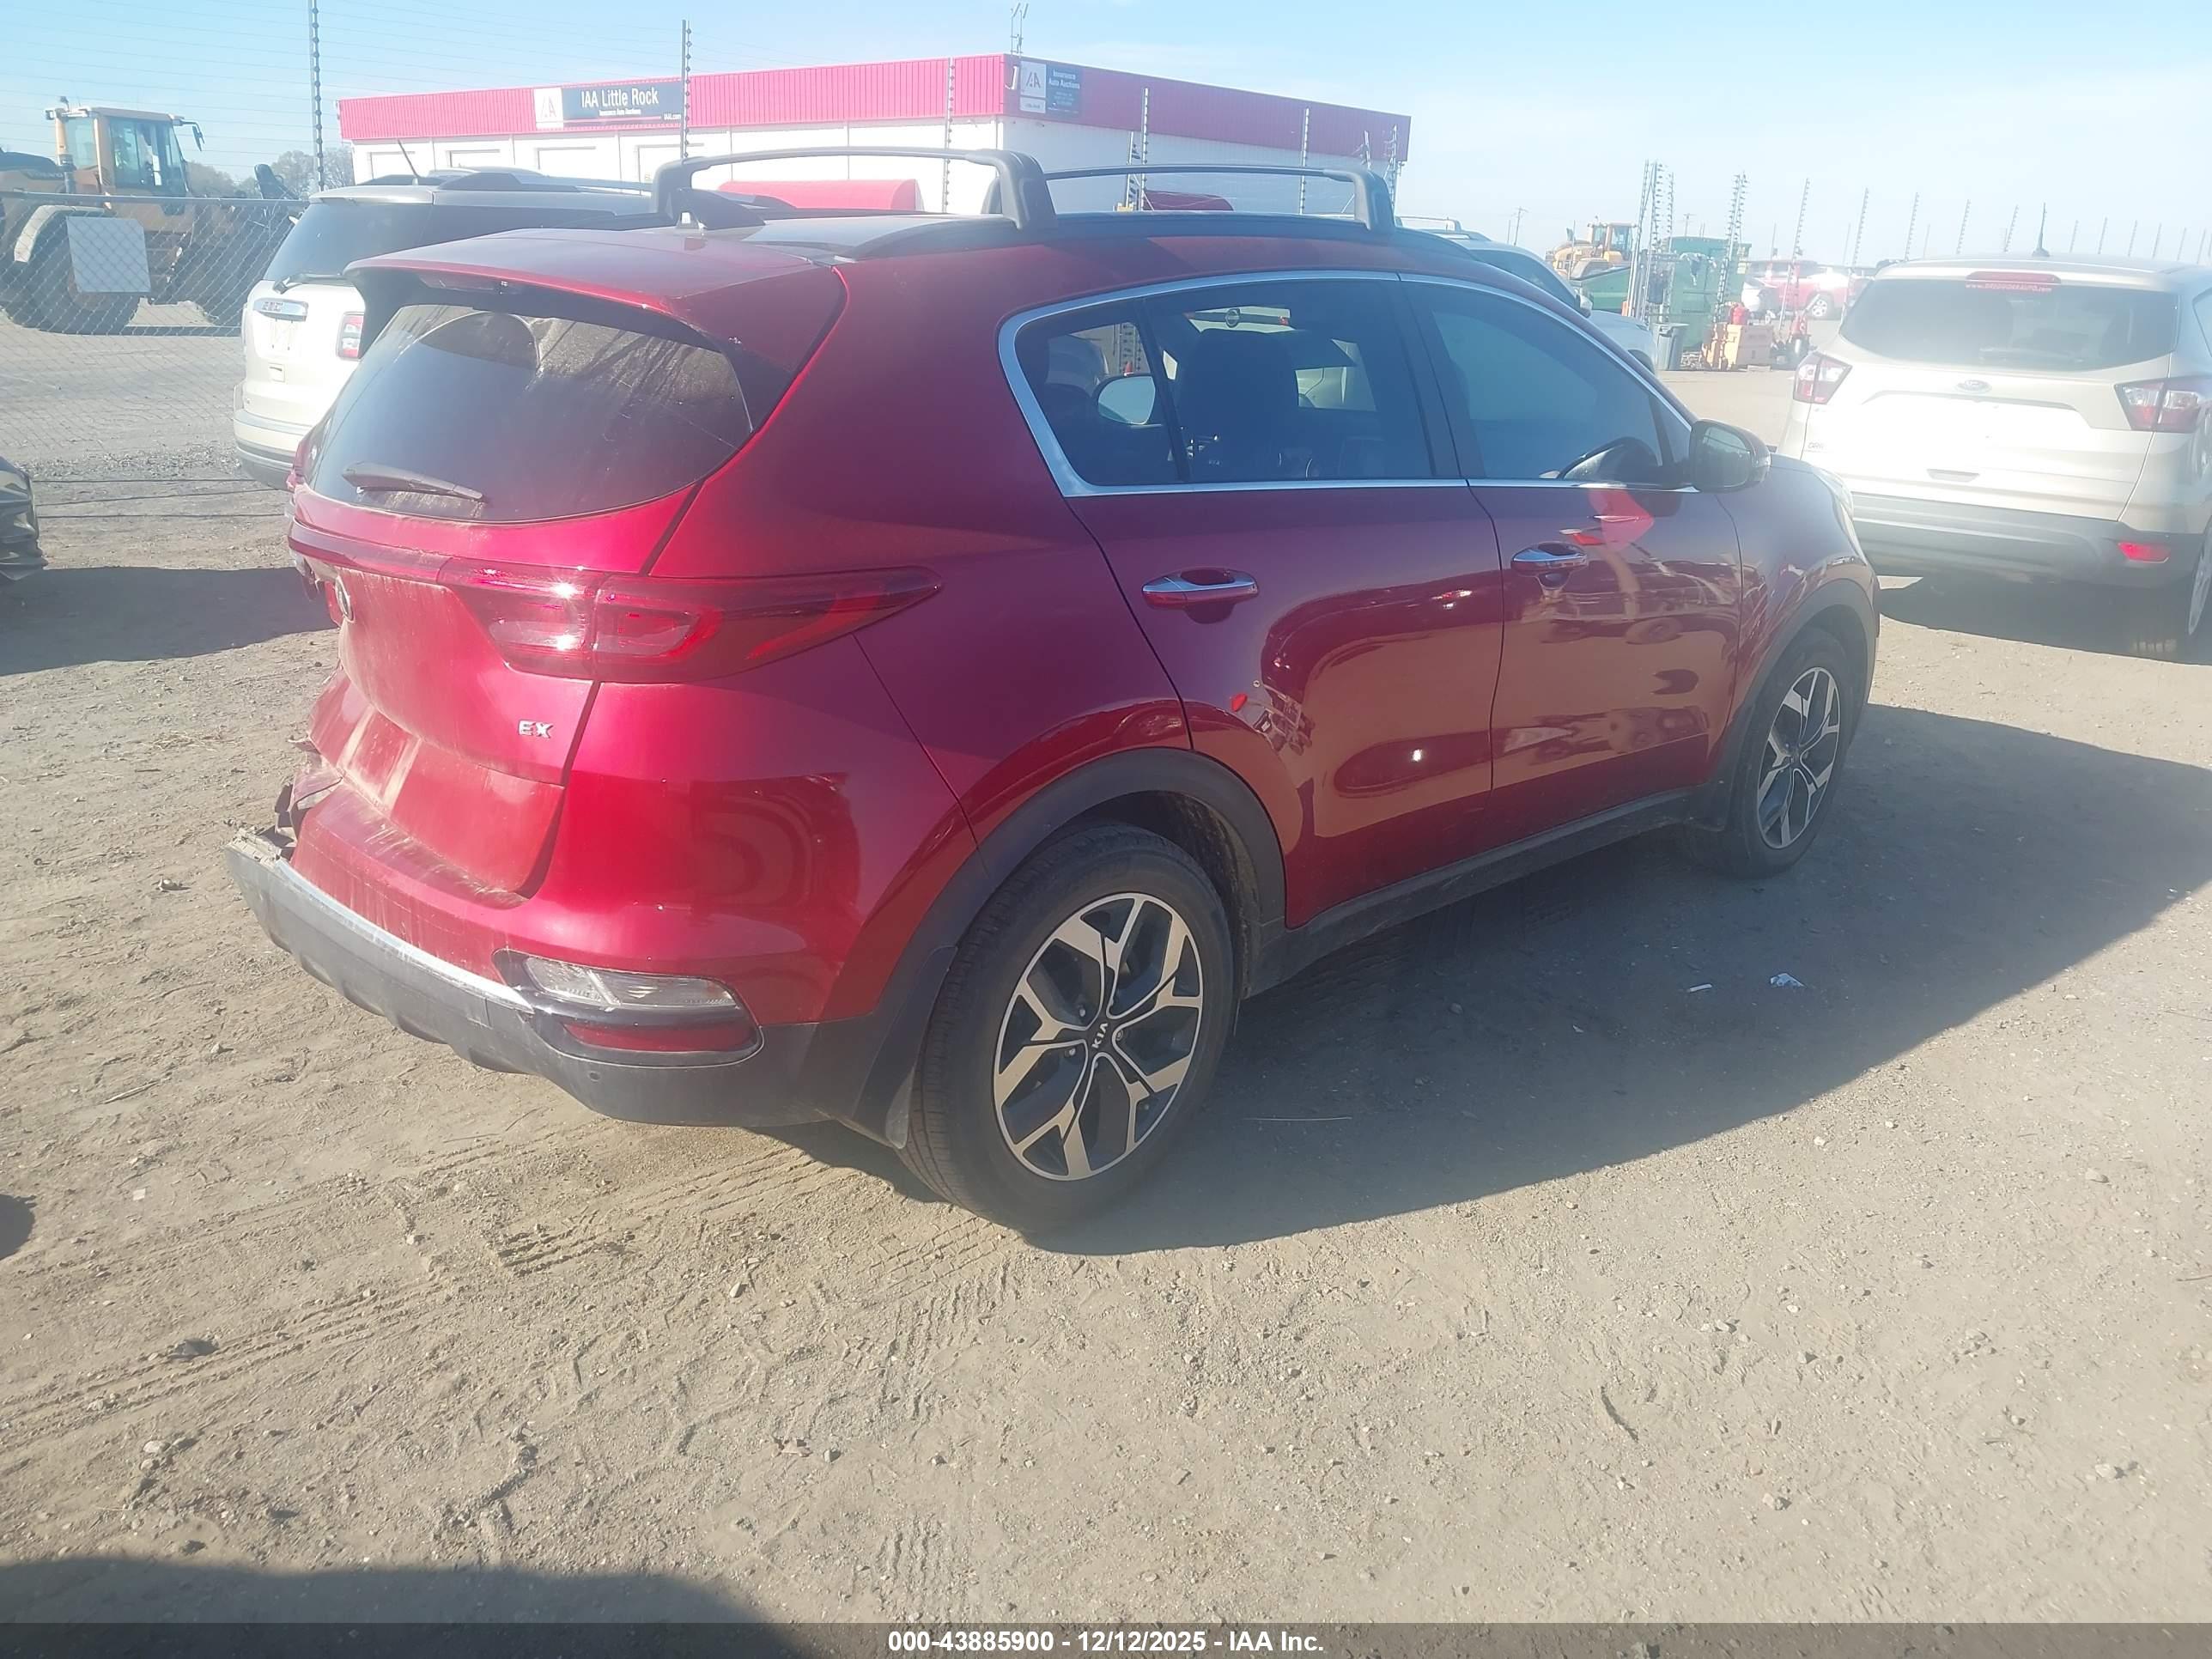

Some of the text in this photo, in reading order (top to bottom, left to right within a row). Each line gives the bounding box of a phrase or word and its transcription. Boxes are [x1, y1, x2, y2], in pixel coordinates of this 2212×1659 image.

[581, 87, 659, 108] IAA Little Rock
[518, 720, 554, 738] EX
[1091, 1023, 1108, 1048] KIA
